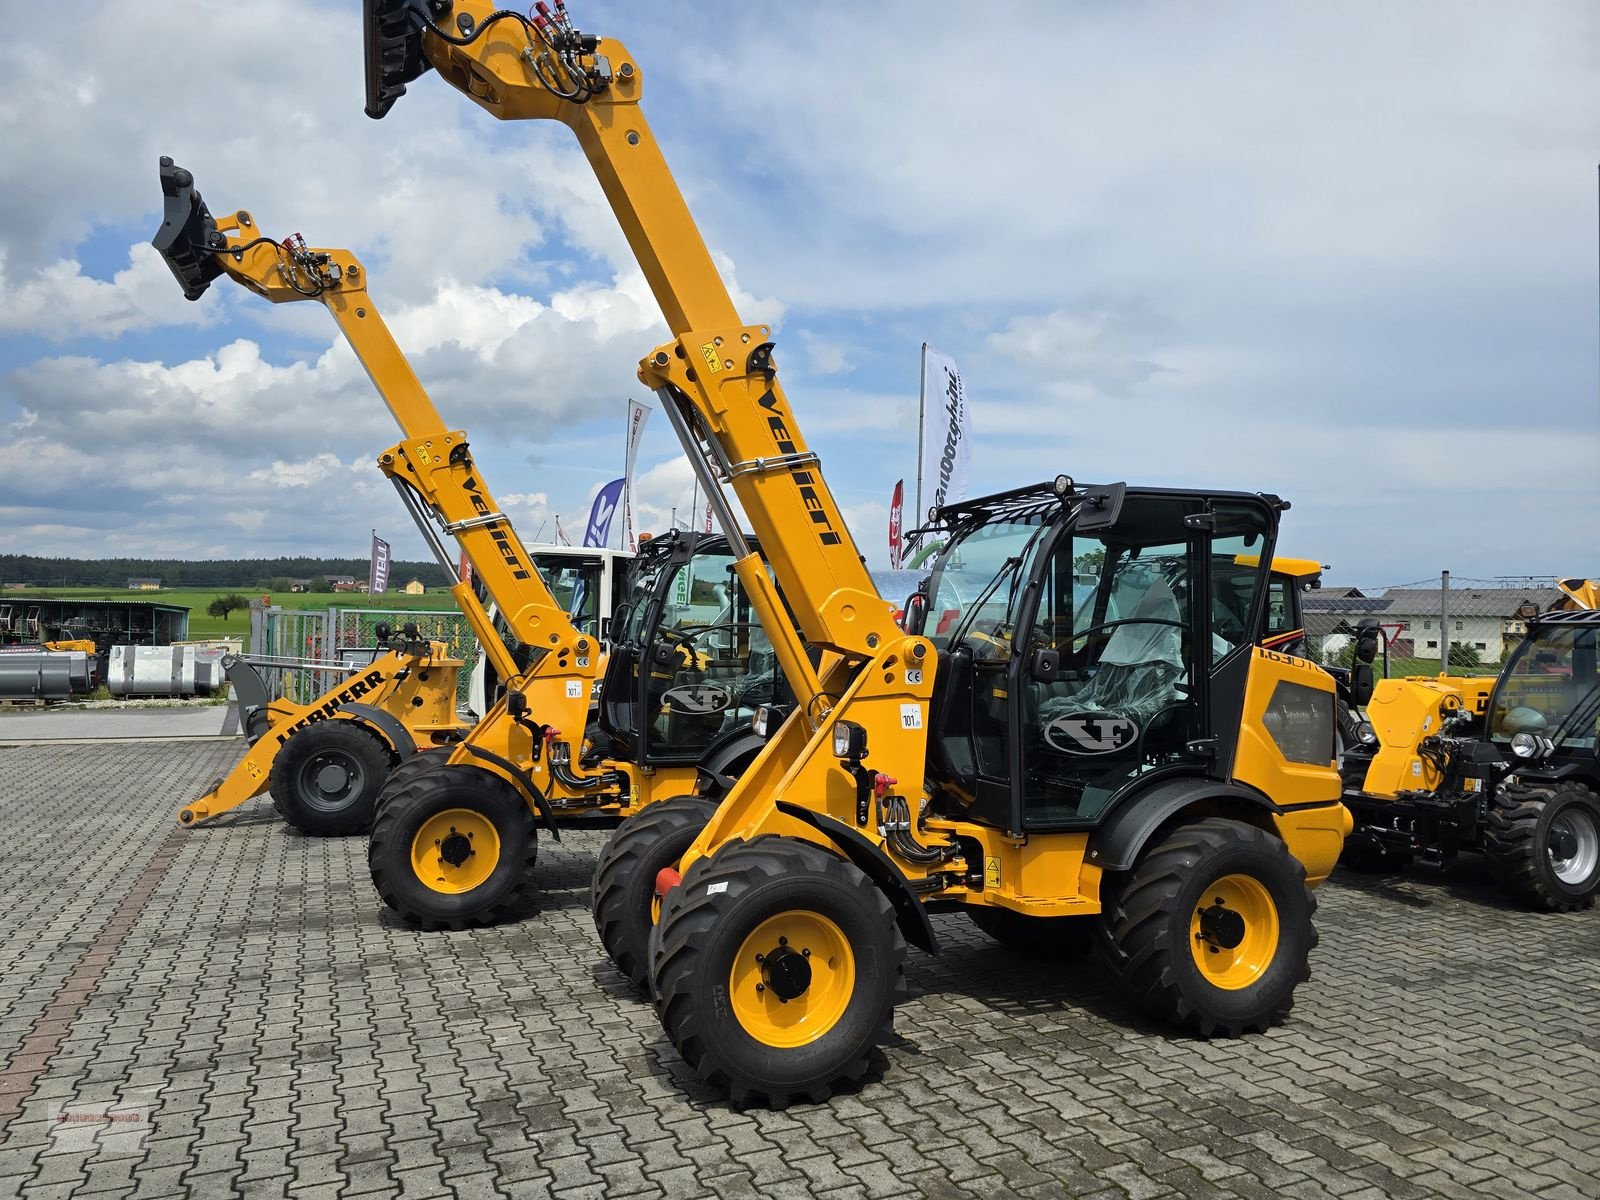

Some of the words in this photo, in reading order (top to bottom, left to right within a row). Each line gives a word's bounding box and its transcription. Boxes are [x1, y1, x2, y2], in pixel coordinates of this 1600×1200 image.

[907, 671, 920, 682] CE
[276, 670, 386, 745] LIEBHERR
[902, 715, 915, 727] 101
